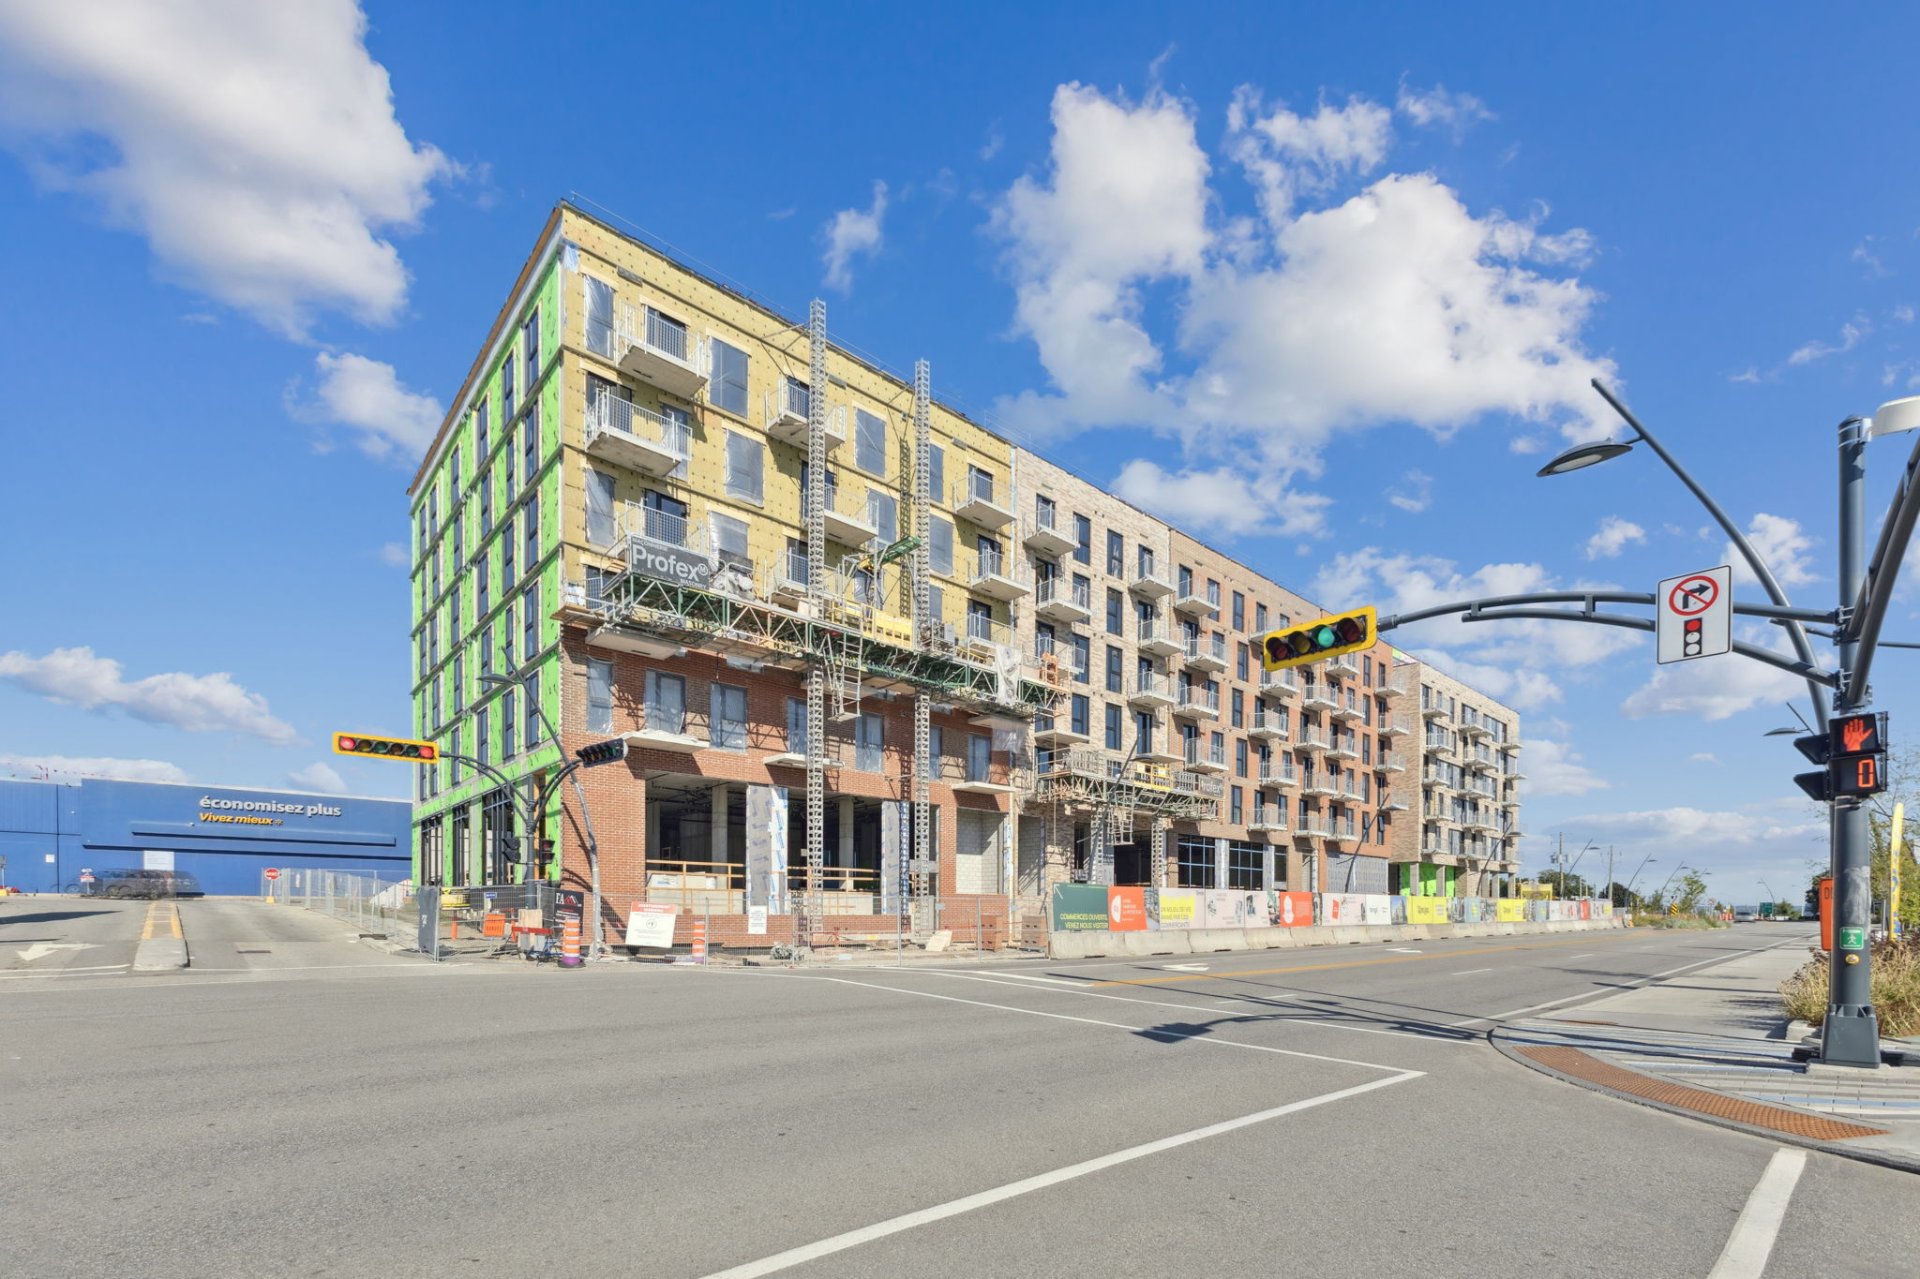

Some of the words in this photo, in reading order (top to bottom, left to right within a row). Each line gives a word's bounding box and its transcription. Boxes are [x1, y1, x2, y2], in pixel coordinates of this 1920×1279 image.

[632, 543, 699, 582] Profex
[1857, 759, 1874, 789] 0
[199, 795, 305, 814] économisez
[305, 803, 343, 818] plus
[199, 812, 233, 824] Vivez
[234, 814, 274, 826] mieux
